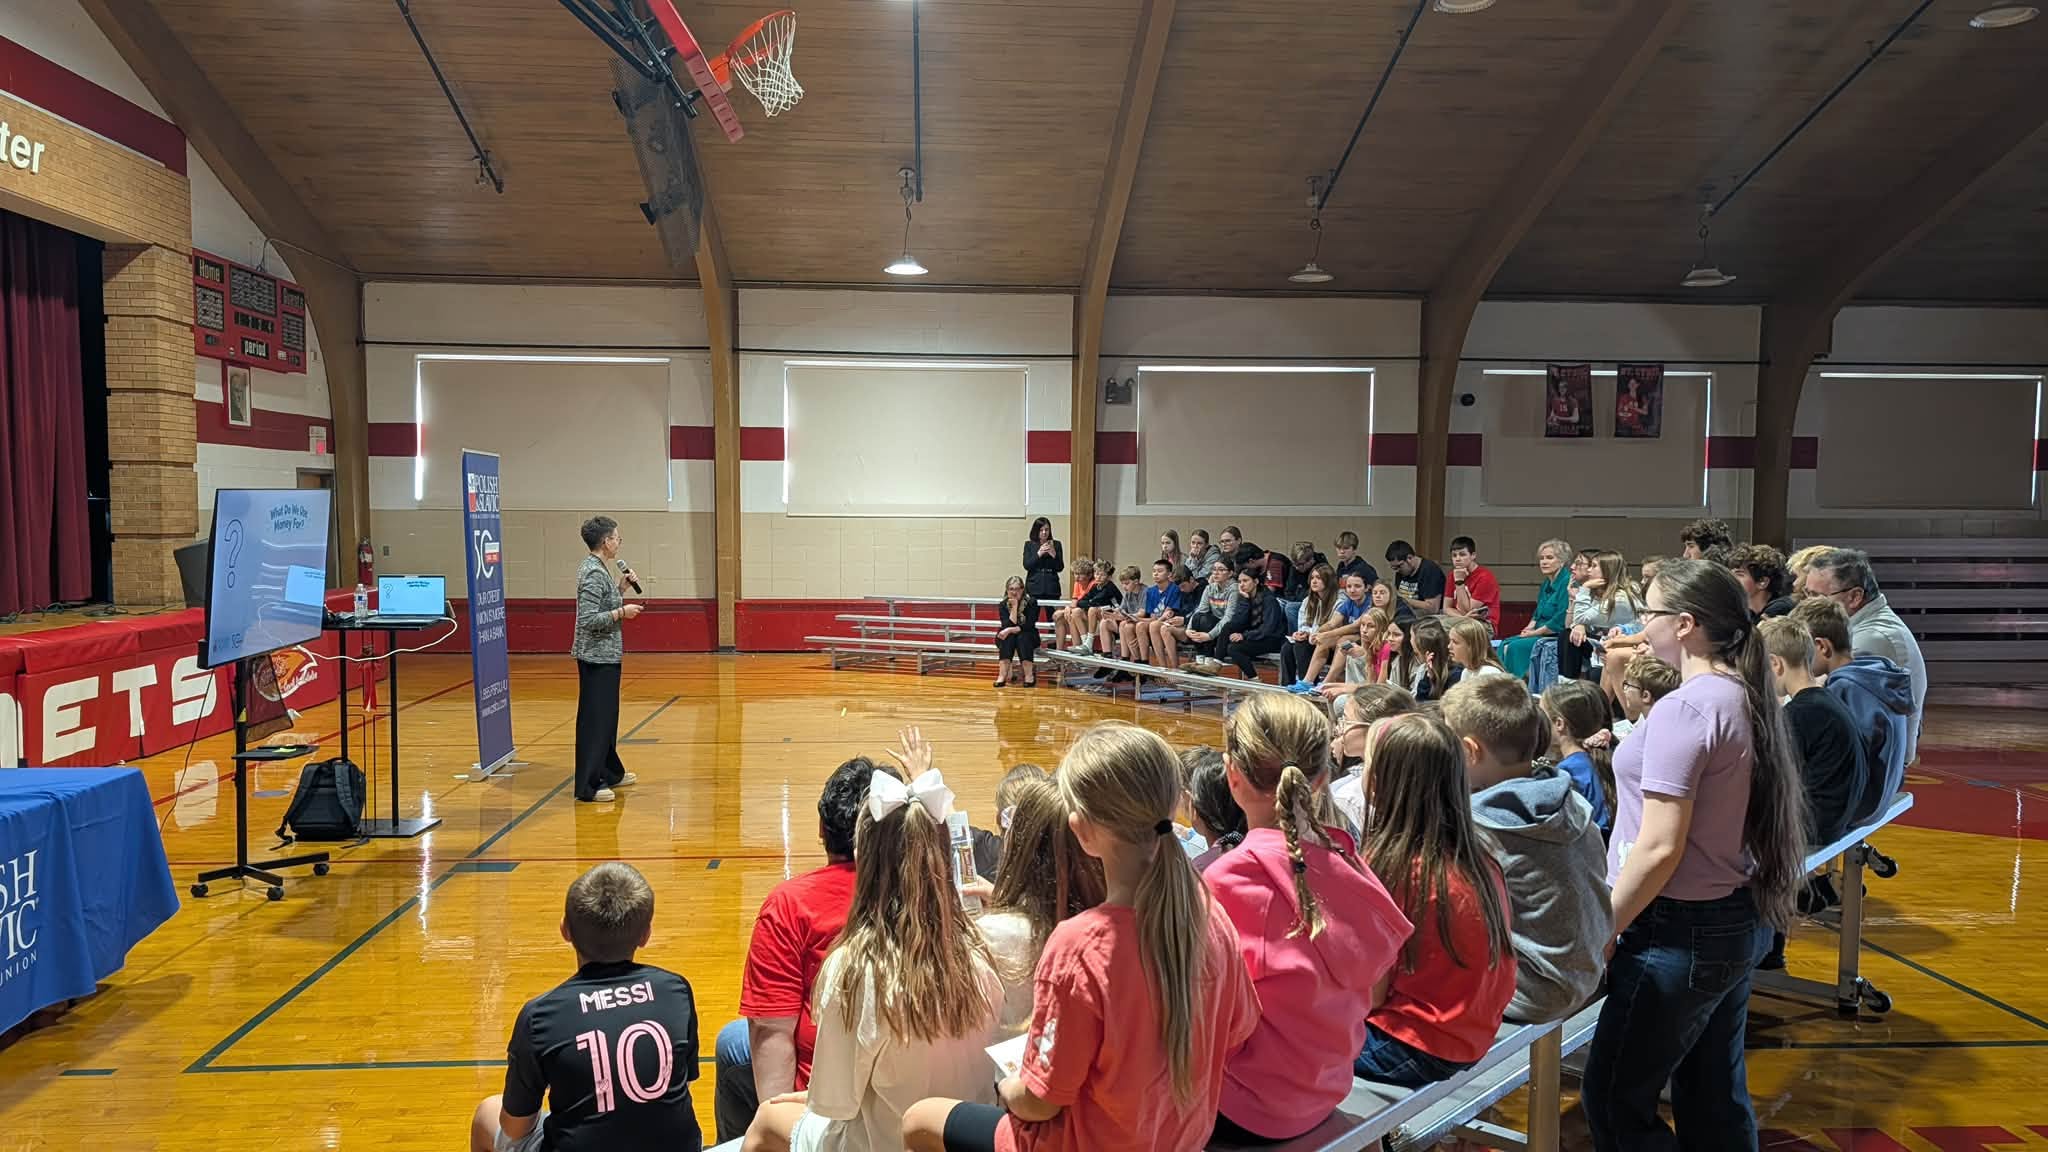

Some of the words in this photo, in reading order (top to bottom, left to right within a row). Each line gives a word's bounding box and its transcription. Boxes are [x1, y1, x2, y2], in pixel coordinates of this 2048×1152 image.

[0, 121, 45, 174] ter
[199, 258, 220, 282] Home
[244, 339, 267, 356] period
[475, 474, 498, 493] POLISH
[269, 505, 283, 520] What
[284, 504, 291, 515] Do
[292, 503, 299, 516] We
[274, 519, 292, 533] Money
[292, 517, 305, 529] For?
[579, 981, 655, 1013] MESSI
[575, 1019, 673, 1113] 10
